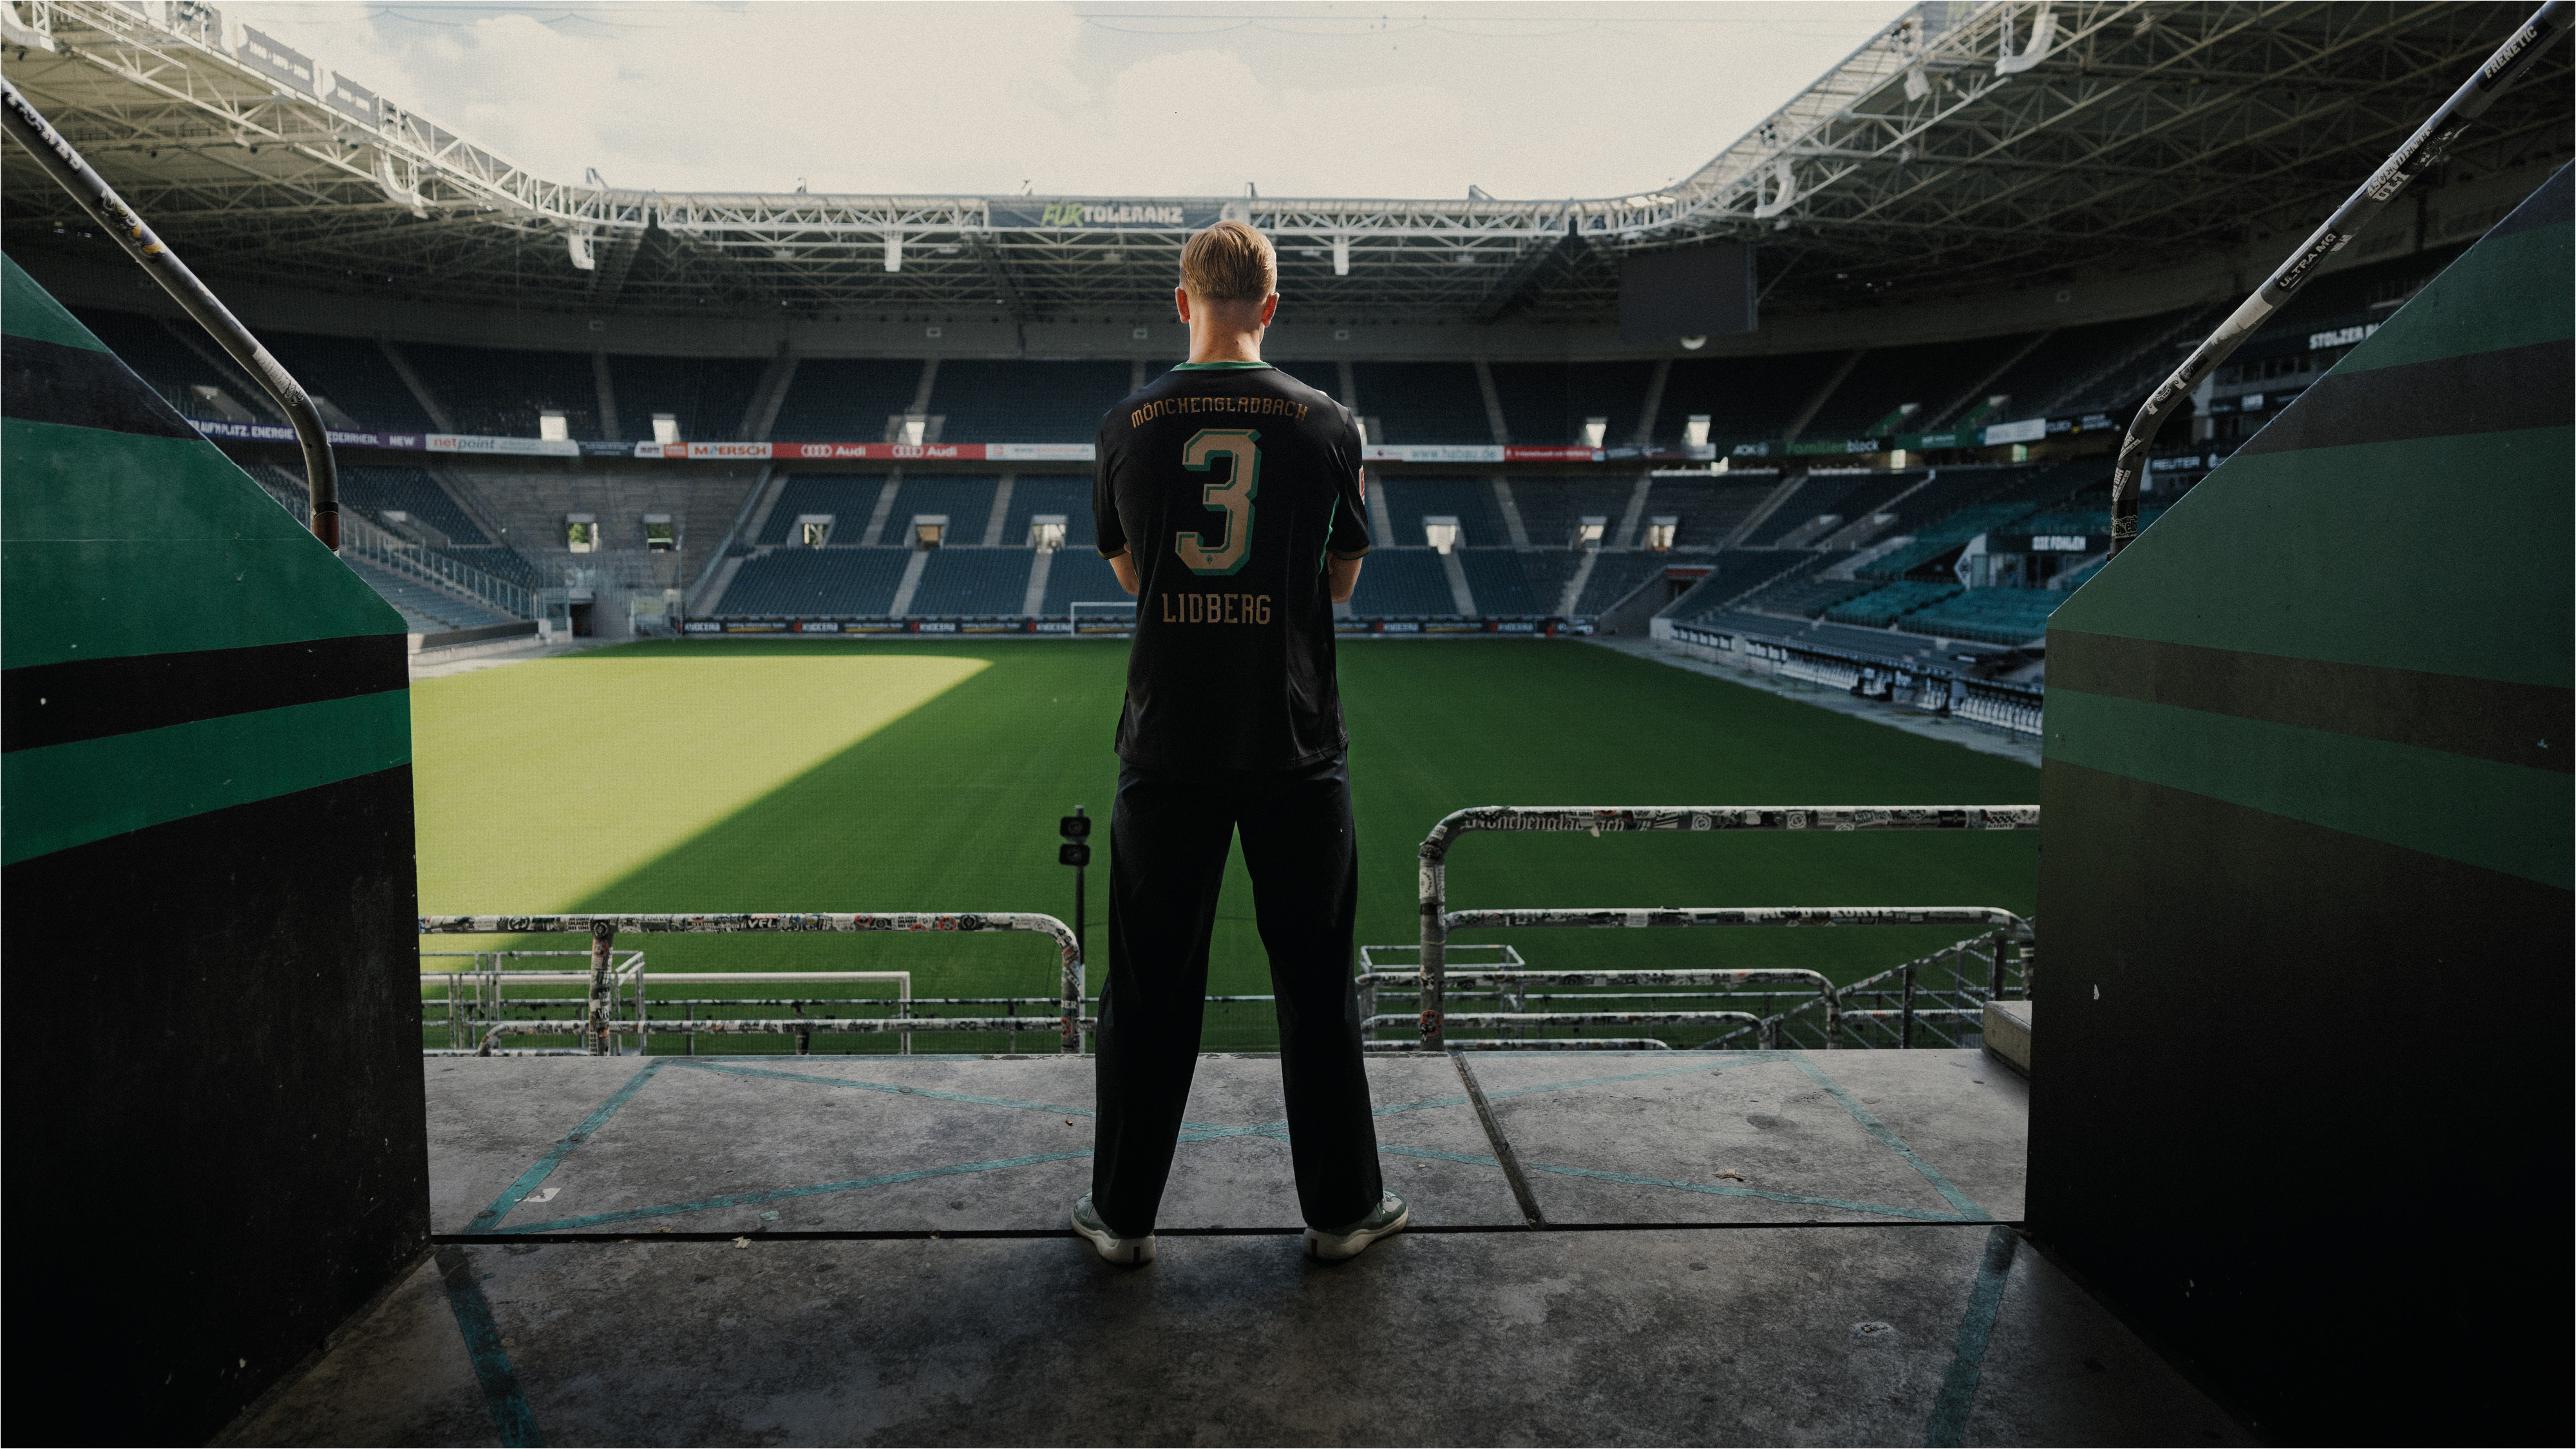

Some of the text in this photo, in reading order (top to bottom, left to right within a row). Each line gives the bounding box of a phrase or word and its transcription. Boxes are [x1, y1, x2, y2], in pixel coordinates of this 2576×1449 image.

[2484, 24, 2538, 79] FRENETIC
[1083, 204, 1184, 224] TOLERANZ
[2280, 232, 2337, 287] ULTRA MG
[1132, 397, 1309, 428] MÖNCHENGLADBACH
[222, 424, 250, 437] PLATZ.
[251, 427, 294, 440] ENERGIE
[390, 435, 414, 447] NEW
[433, 437, 496, 450] netpoint
[836, 445, 866, 456] Audi
[927, 446, 957, 457] Audi
[2152, 456, 2201, 469] REUTER
[1175, 428, 1262, 576] 3
[1162, 593, 1271, 625] LIDBERG
